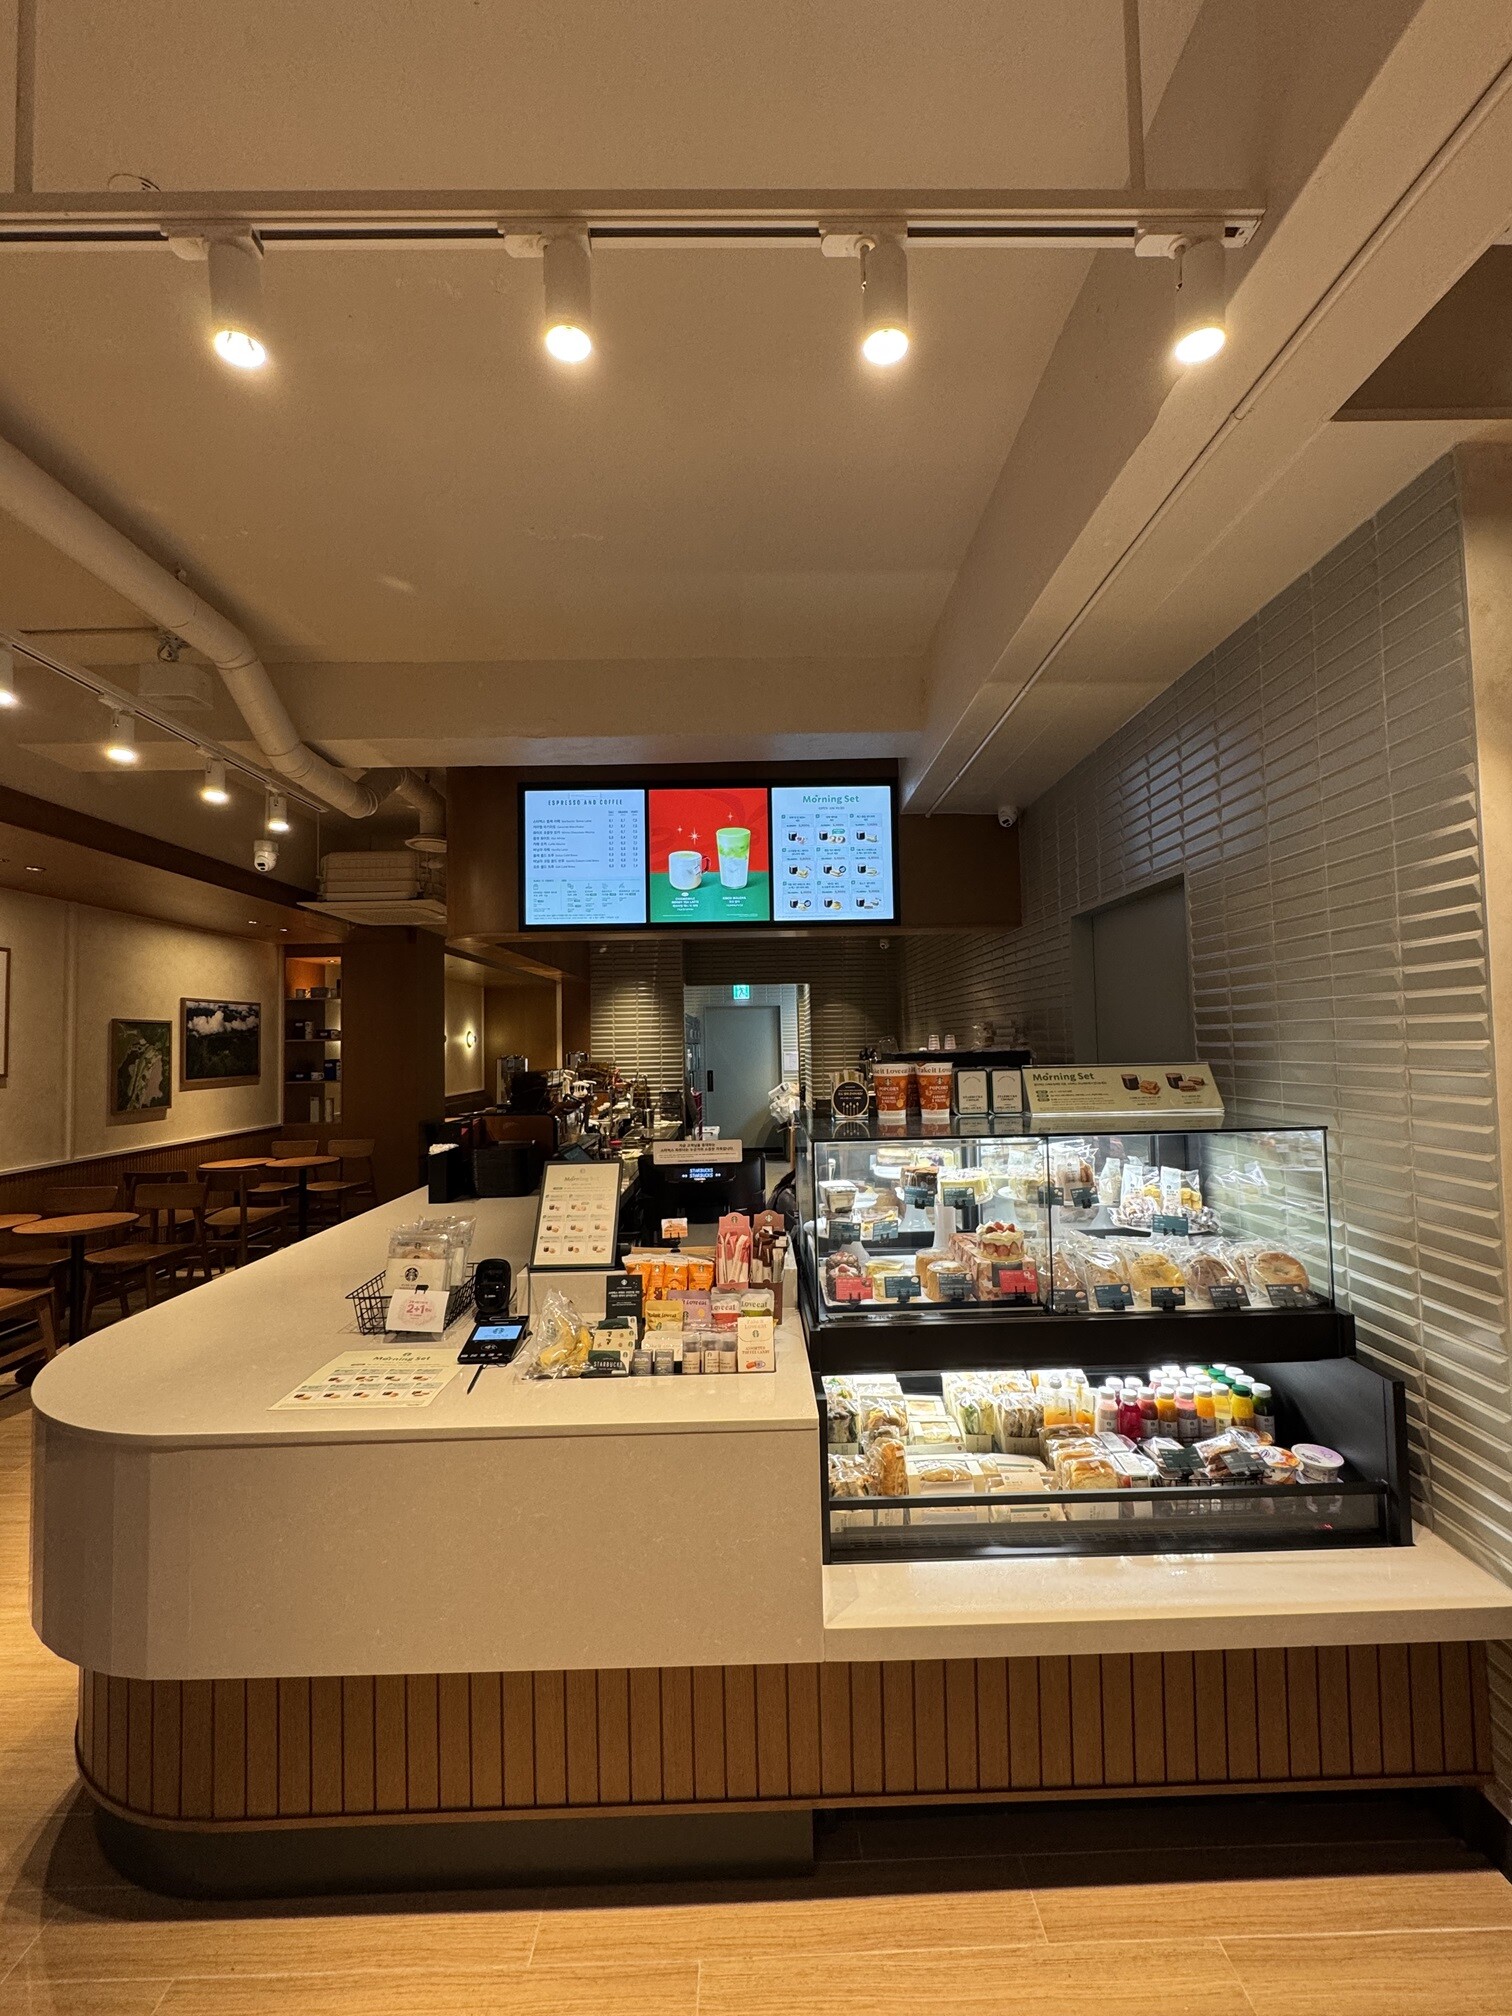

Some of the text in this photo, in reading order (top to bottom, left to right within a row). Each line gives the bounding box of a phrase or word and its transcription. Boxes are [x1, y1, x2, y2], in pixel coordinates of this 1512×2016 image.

[802, 795, 842, 804] Morning
[1033, 1072, 1076, 1082] Morning
[406, 1304, 425, 1314] 2+1
